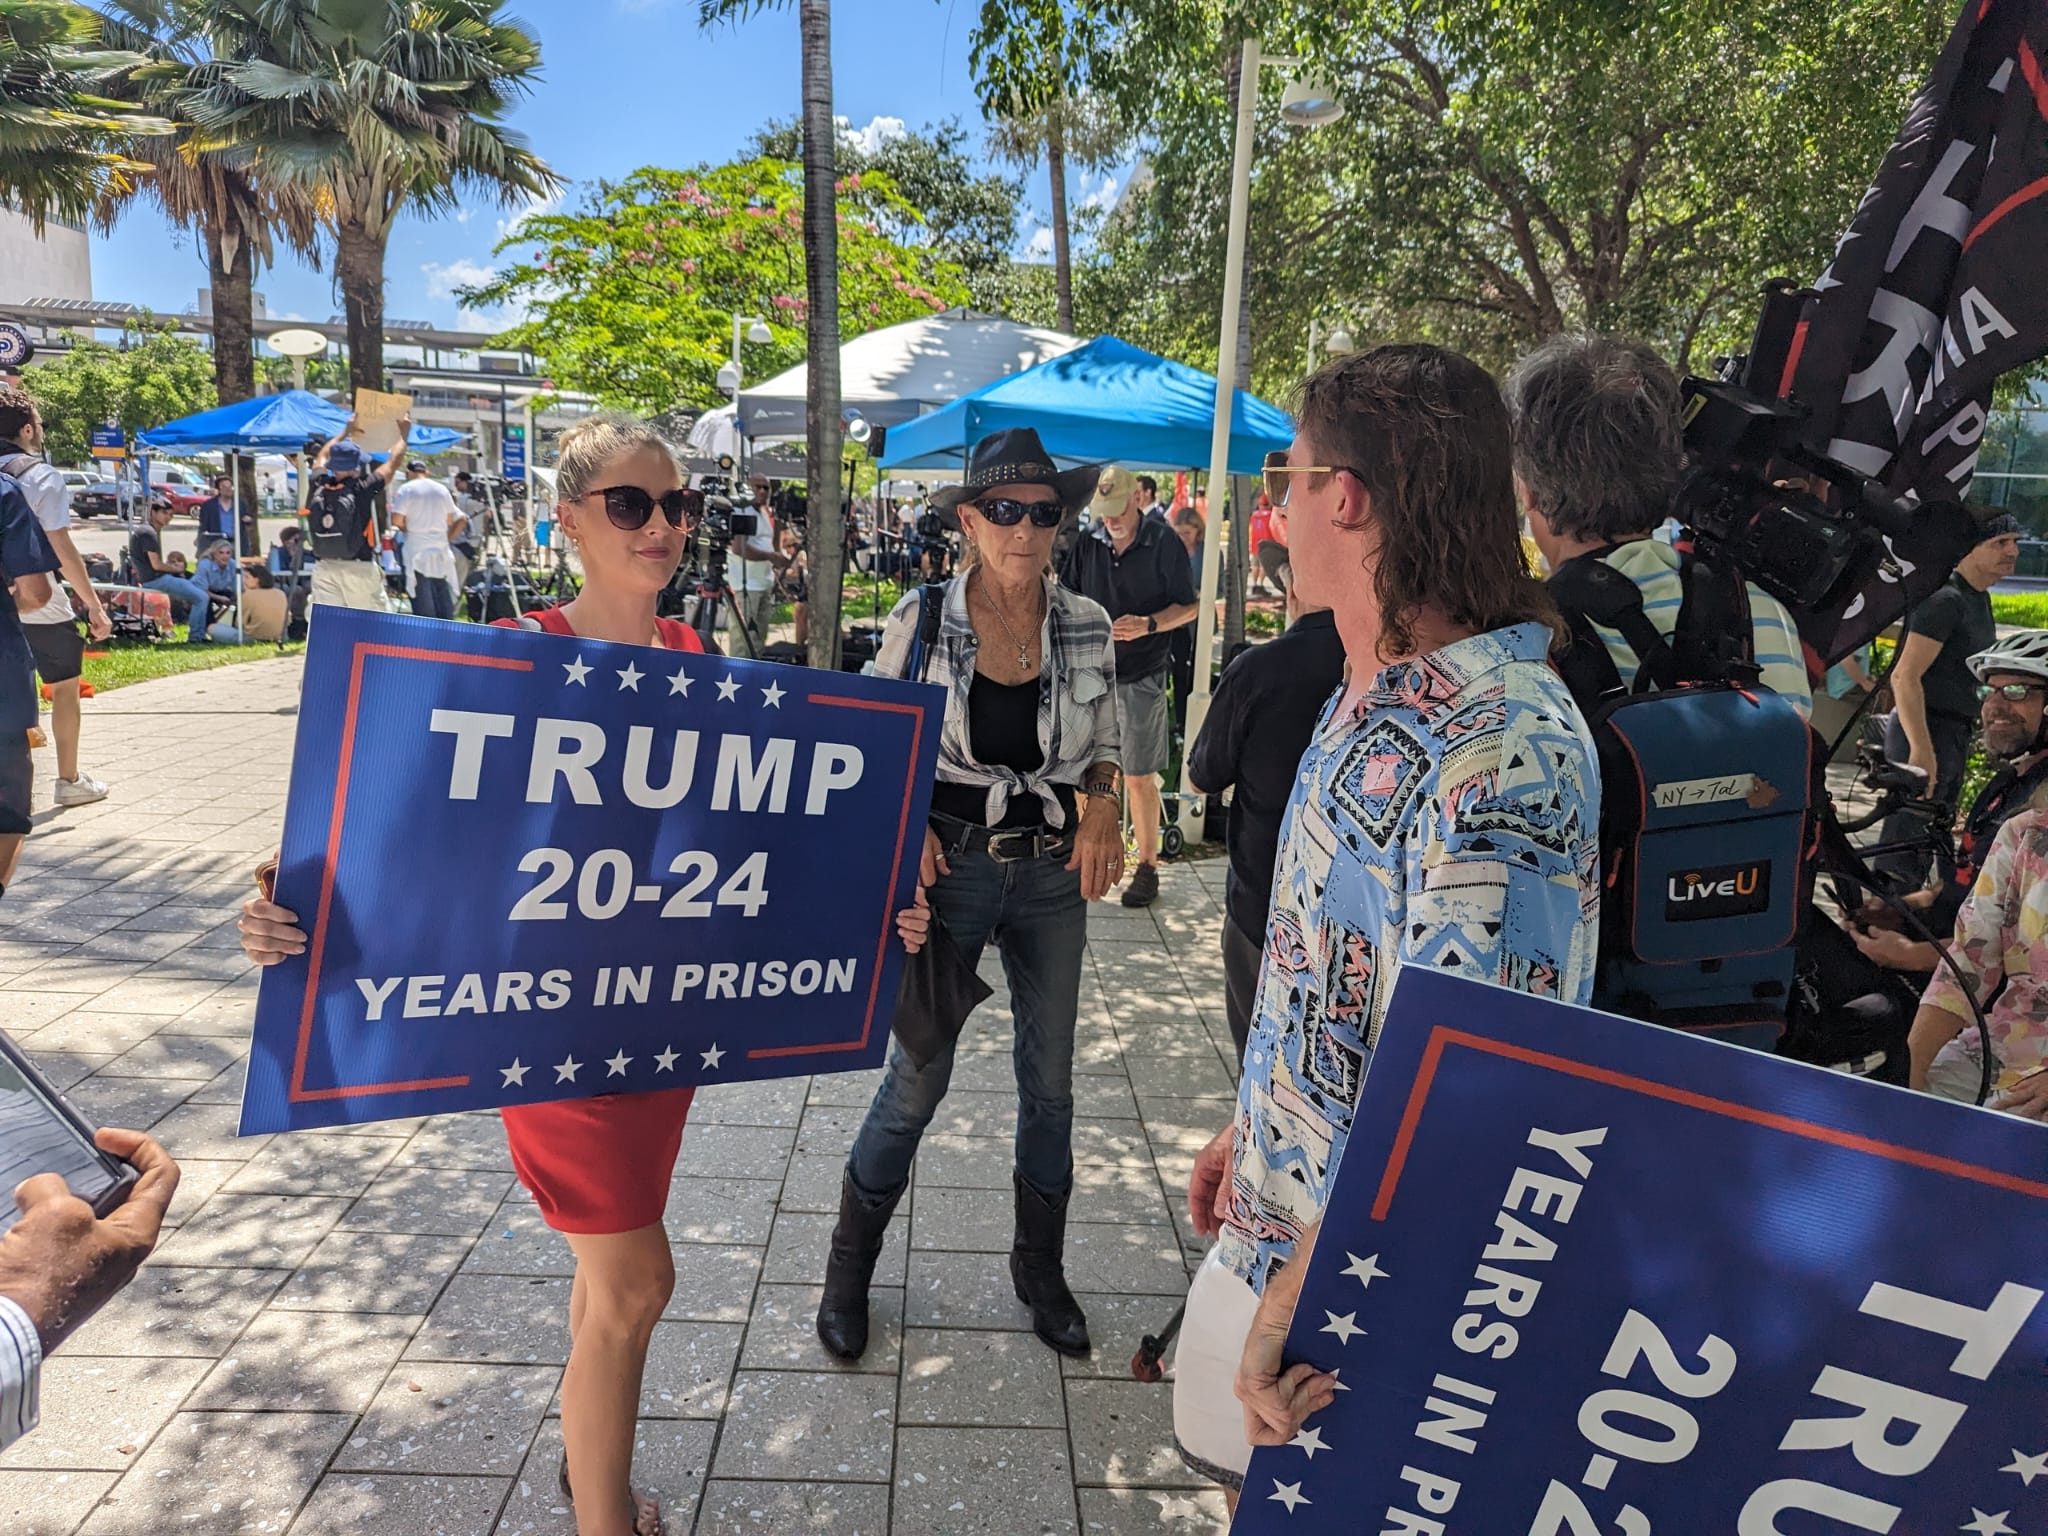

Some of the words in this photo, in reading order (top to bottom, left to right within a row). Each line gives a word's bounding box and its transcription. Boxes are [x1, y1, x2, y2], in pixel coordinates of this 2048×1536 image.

[429, 708, 865, 815] TRUMP
[1662, 786, 1687, 806] NY
[507, 847, 770, 921] 20-24
[354, 967, 573, 1021] YEARS
[593, 965, 654, 1006] IN
[670, 958, 858, 1003] PRISON
[1451, 1126, 1609, 1360] YEARS
[1414, 1372, 1497, 1455] IN
